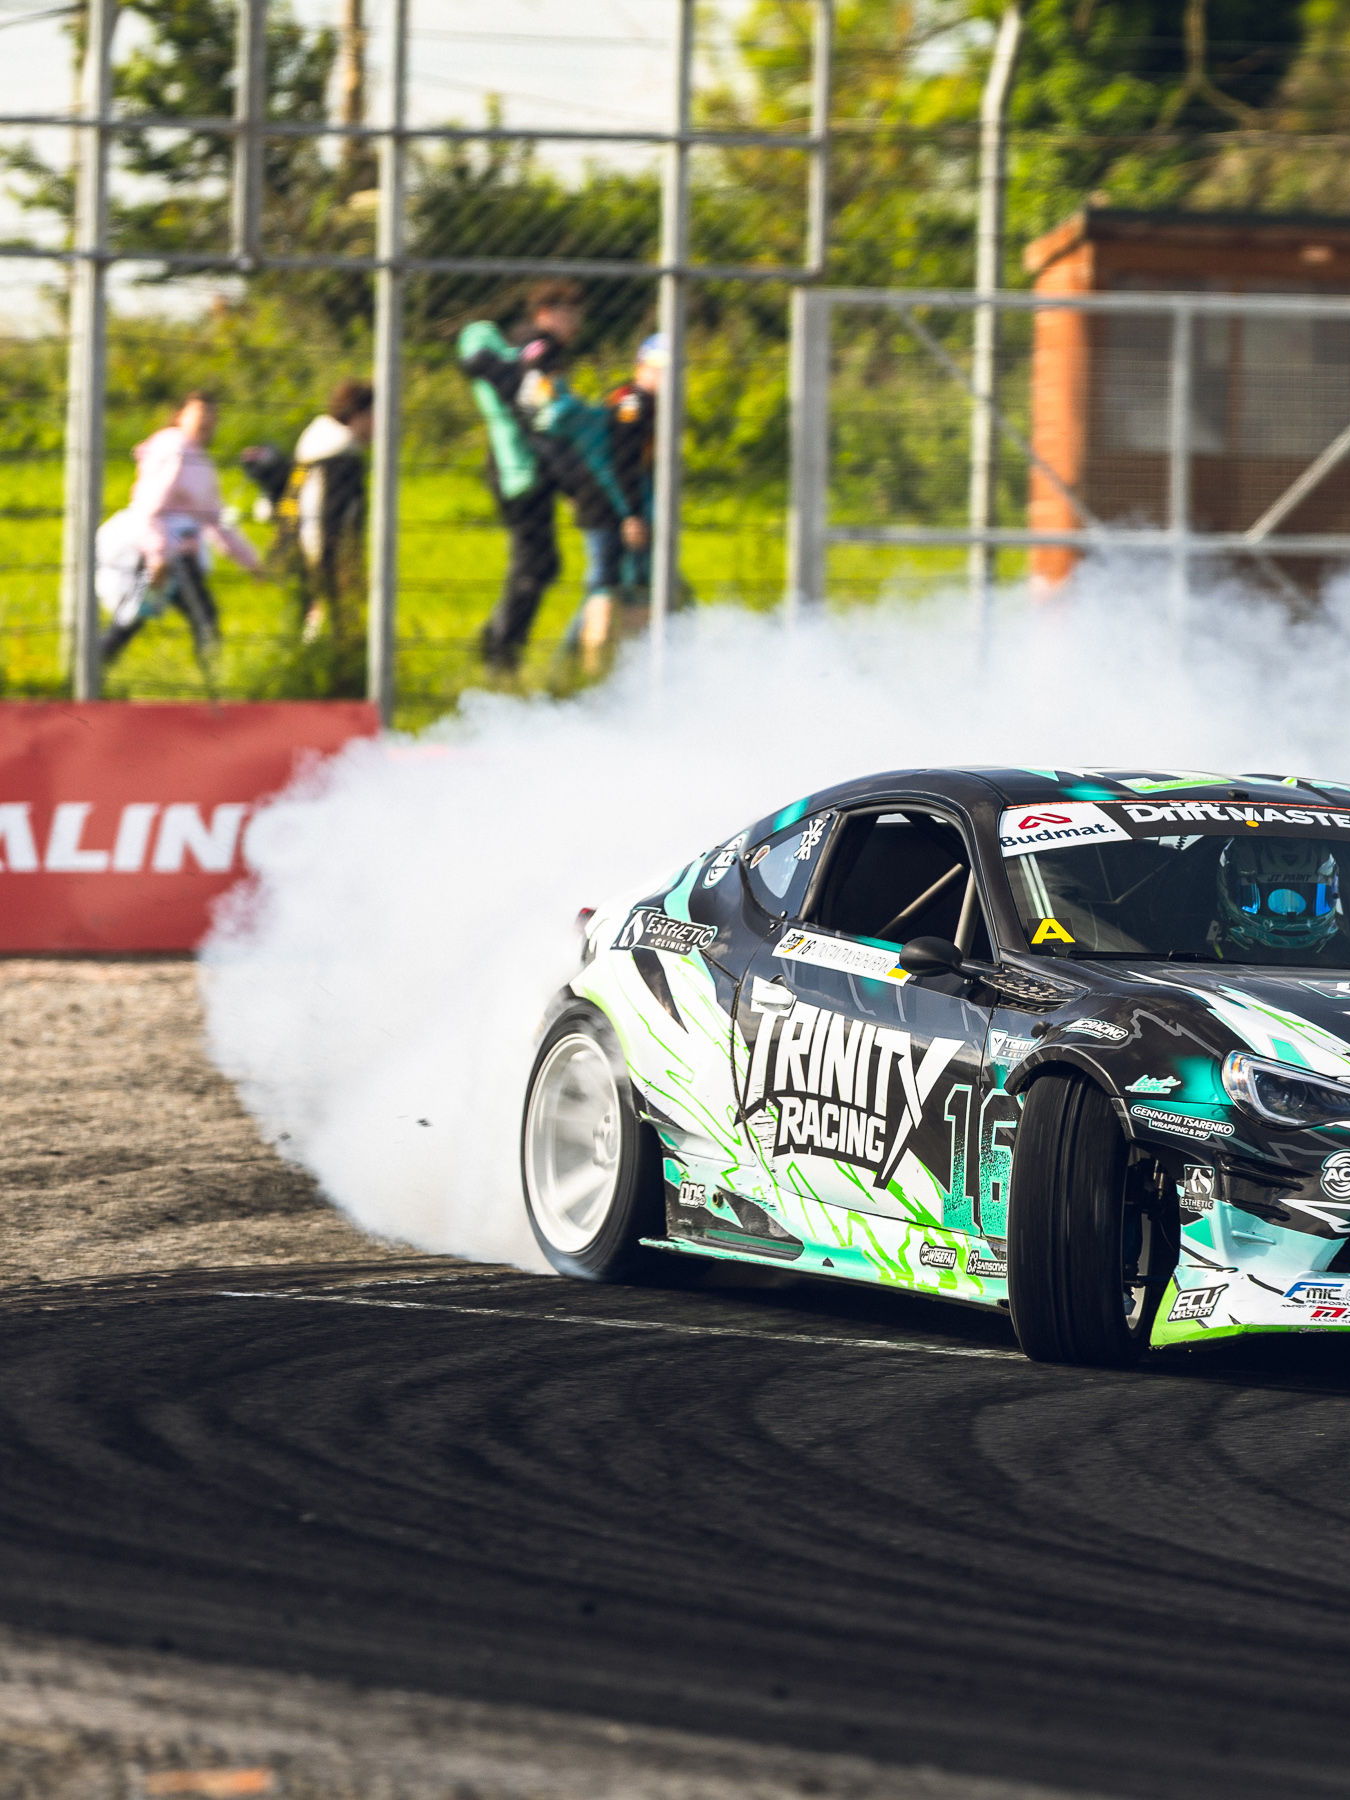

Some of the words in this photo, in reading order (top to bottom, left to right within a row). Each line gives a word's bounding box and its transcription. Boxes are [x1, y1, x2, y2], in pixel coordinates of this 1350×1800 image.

[645, 917, 714, 946] ESTHETIC
[1030, 918, 1076, 945] A
[745, 977, 966, 1180] TRINITY
[776, 1097, 887, 1164] RACING
[1151, 1120, 1188, 1134] WRAPPING
[1183, 1117, 1233, 1134] TSARENKO
[942, 1083, 1024, 1239] 16
[1181, 1199, 1213, 1208] ESTHETIC
[1173, 1287, 1225, 1311] ECU
[1169, 1308, 1213, 1320] MASTER
